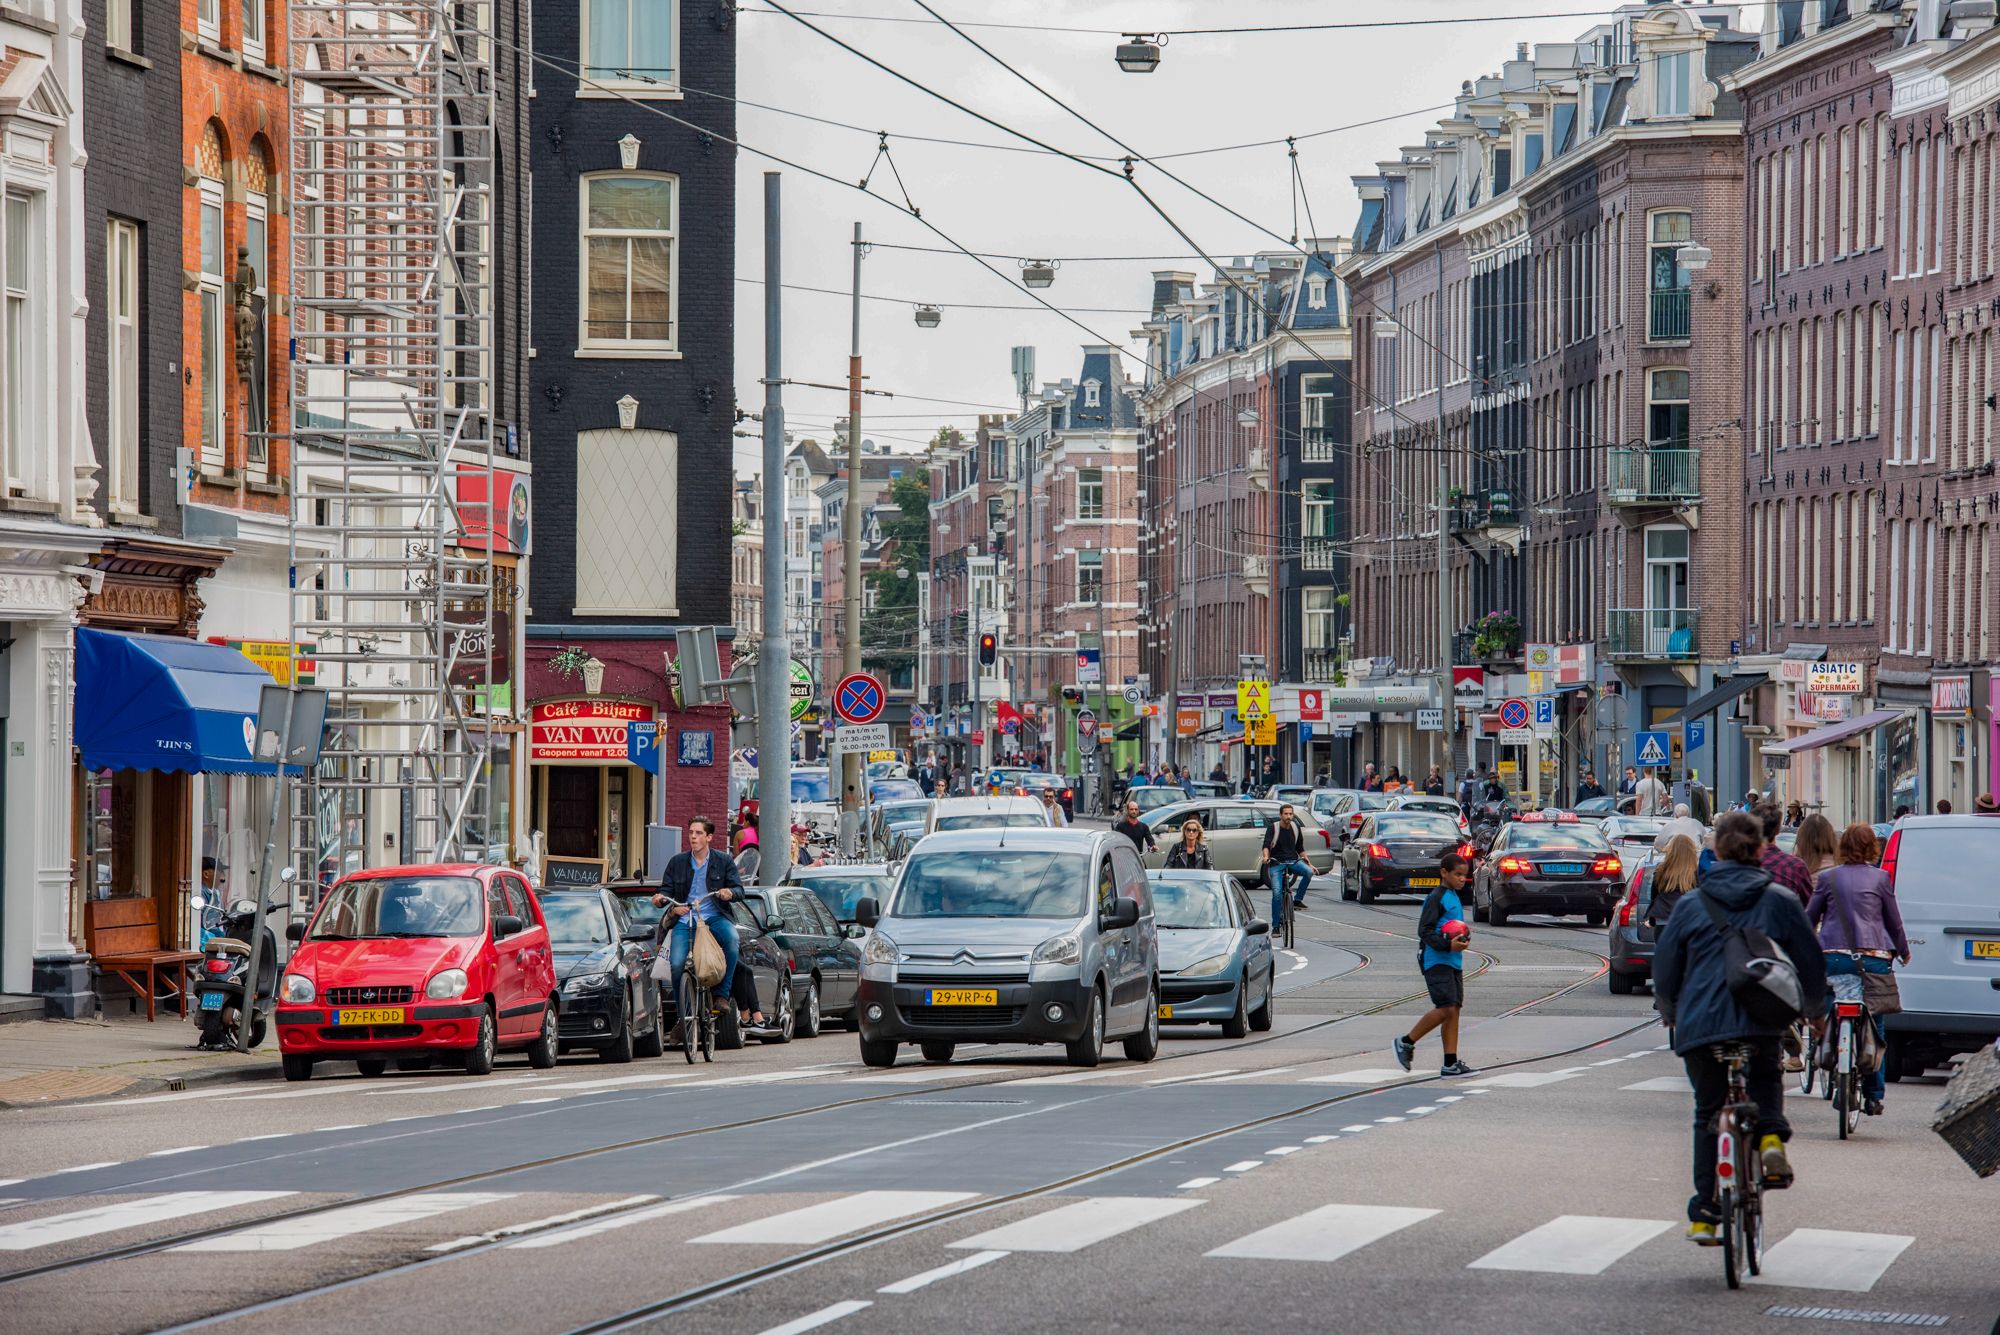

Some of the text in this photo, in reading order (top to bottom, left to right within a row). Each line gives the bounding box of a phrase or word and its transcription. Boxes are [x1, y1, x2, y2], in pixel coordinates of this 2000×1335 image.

[1811, 663, 1857, 674] ASIATIC
[1454, 685, 1483, 697] Marlboro
[1810, 683, 1861, 692] SUPERMARKT
[543, 701, 642, 719] Café Biljart
[543, 727, 585, 744] VAN
[856, 726, 870, 734] t/m
[1692, 730, 1700, 742] P
[156, 739, 192, 750] TJIN'S
[636, 735, 649, 756] P
[538, 749, 577, 759] Geopend
[580, 749, 603, 757] vanaf
[869, 751, 896, 762] DIKS
[552, 867, 599, 882] VANDAAG
[936, 992, 993, 1003] 29-VRP-6
[343, 1011, 400, 1022] 97-FK-DD
